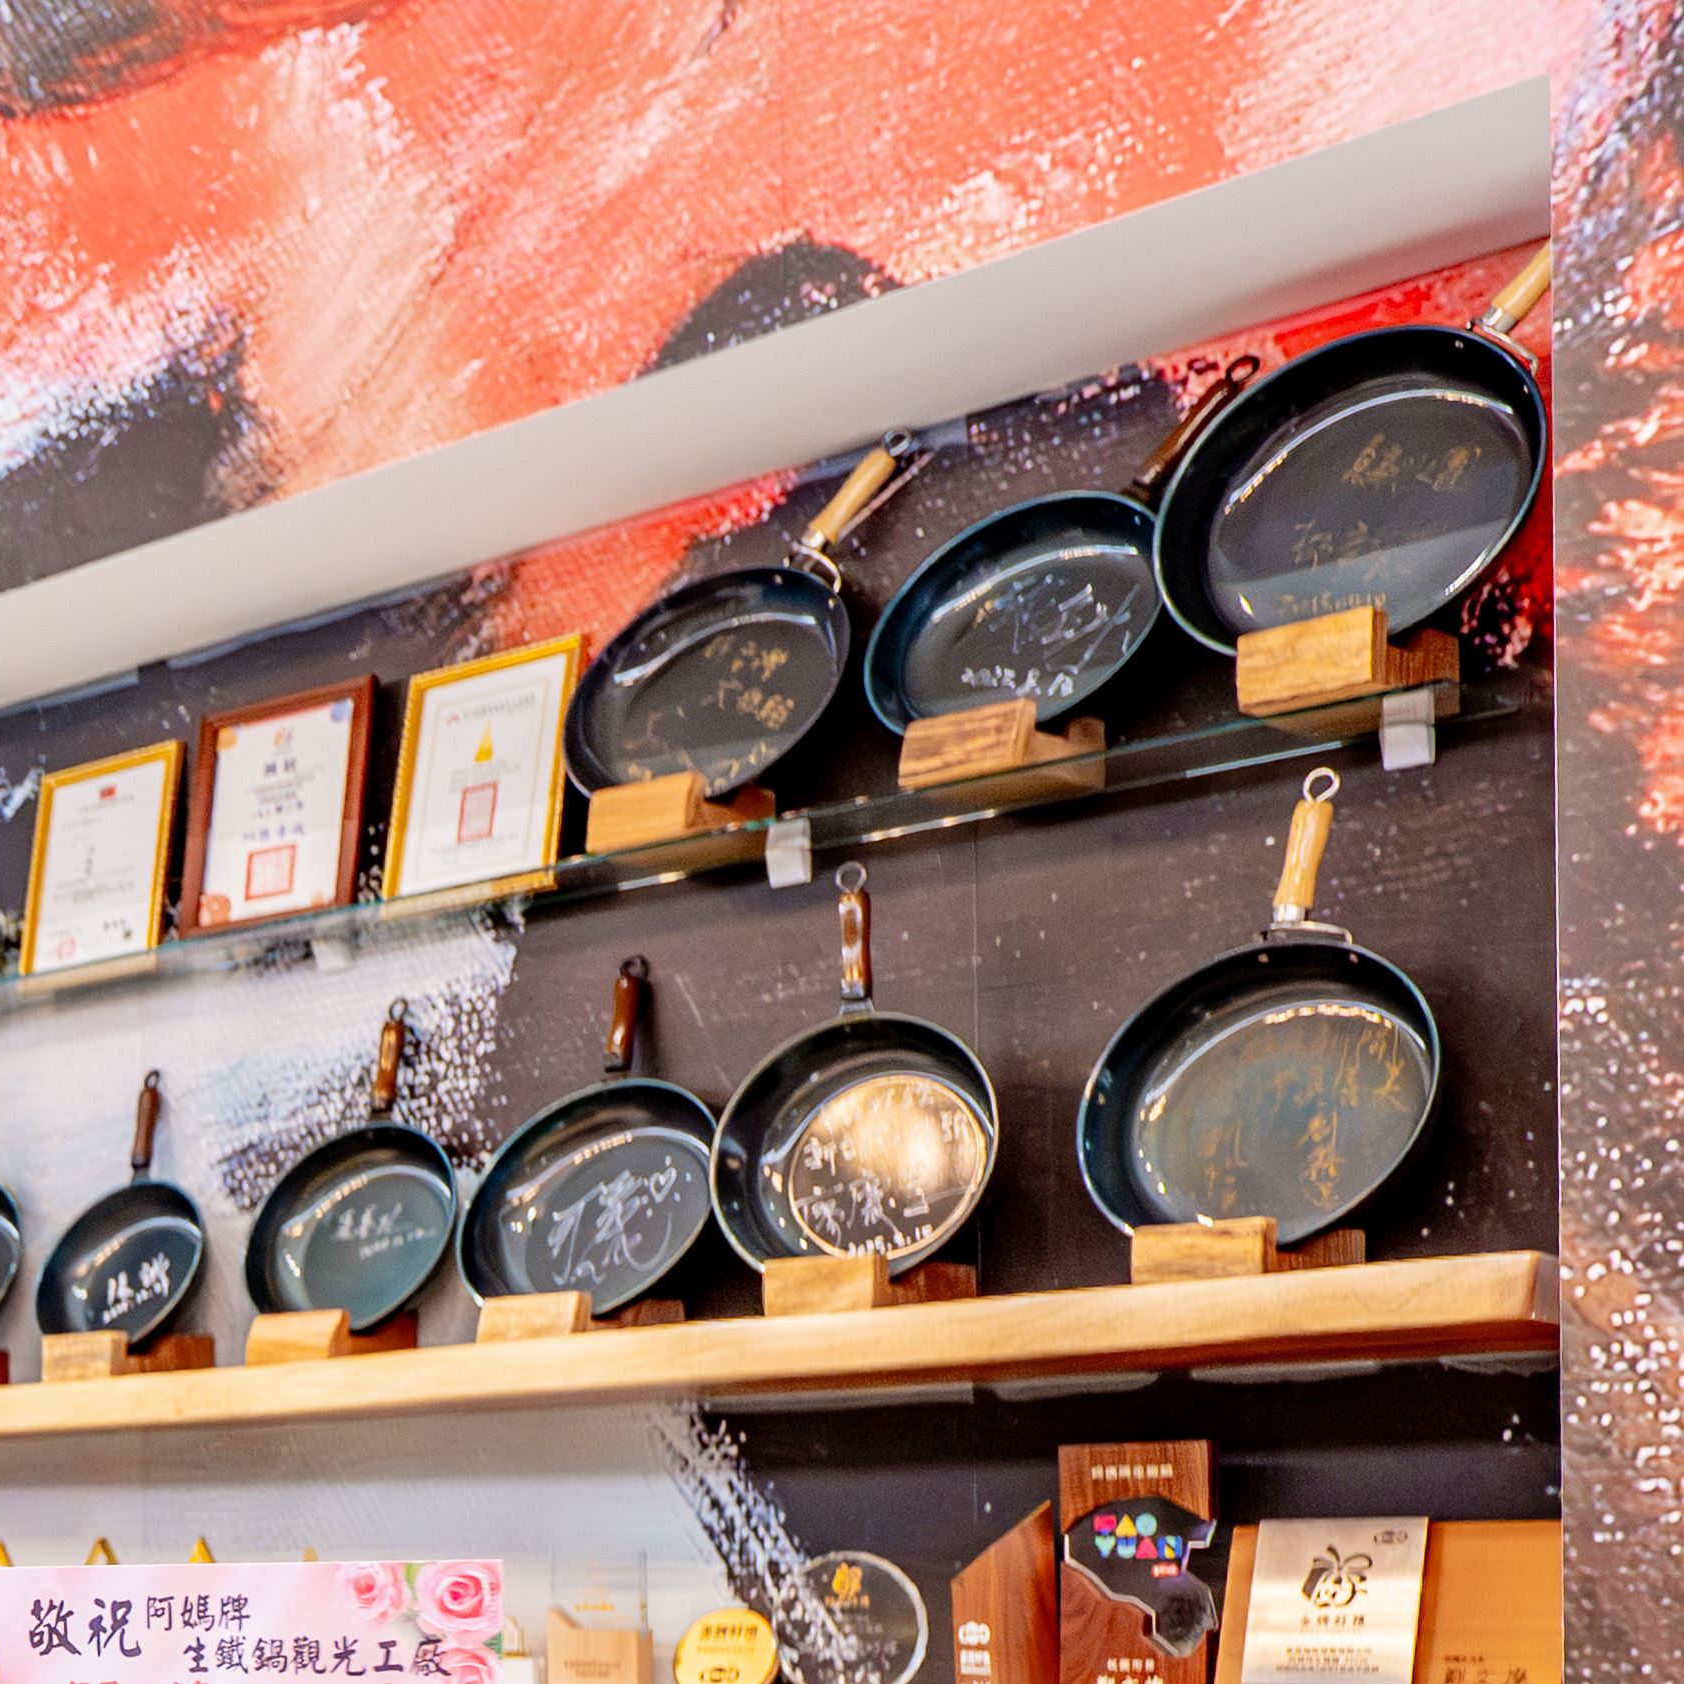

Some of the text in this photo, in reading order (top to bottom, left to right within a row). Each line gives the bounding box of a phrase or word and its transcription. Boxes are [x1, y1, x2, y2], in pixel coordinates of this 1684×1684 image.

[28, 1594, 251, 1658] 敬祝 阿媽牌
[183, 1636, 453, 1677] 生鐵鍋觀光工廠
